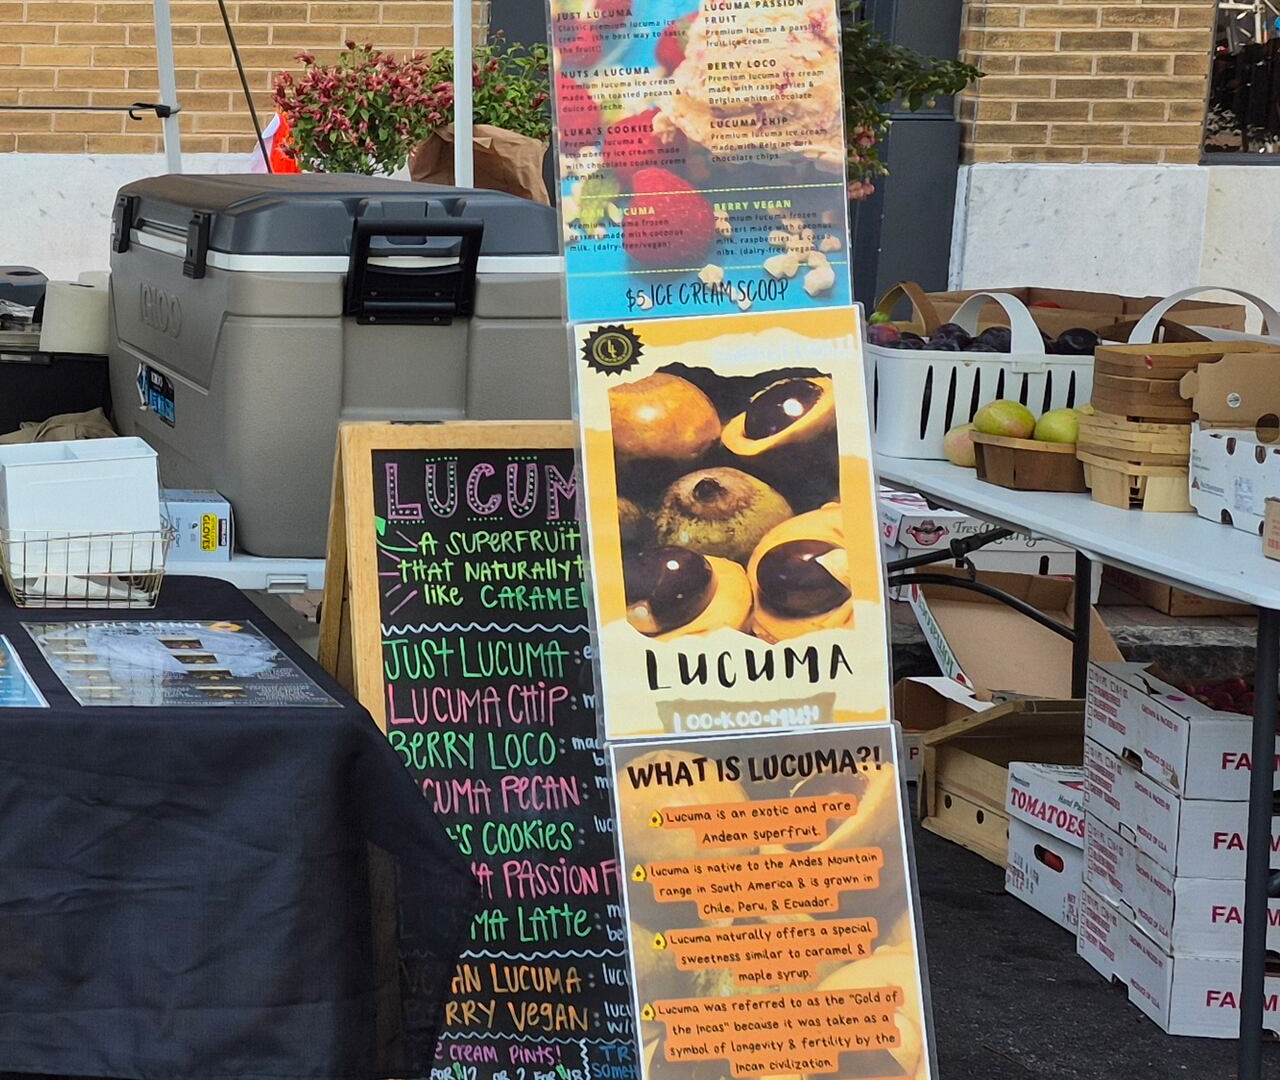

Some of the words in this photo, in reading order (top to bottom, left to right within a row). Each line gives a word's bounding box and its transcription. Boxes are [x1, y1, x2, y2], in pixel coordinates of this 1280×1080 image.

[704, 1, 751, 12] LUCUMA
[704, 15, 737, 24] FRUIT
[707, 61, 742, 71] BERRY
[747, 59, 777, 68] LOCO
[713, 201, 749, 211] BERRY
[754, 199, 791, 210] VEGAN
[626, 288, 645, 312] $5
[651, 283, 673, 305] ICE
[679, 280, 733, 306] CREAM
[738, 277, 789, 301] SCOOP
[460, 637, 570, 678] LUCUMA
[645, 644, 854, 691] LUCUMA
[388, 684, 503, 727] LUCUMA
[627, 758, 708, 789] WHAT
[719, 756, 740, 782] IS
[748, 746, 882, 782] LUCUMA?!
[666, 810, 712, 823] Lucuma
[716, 809, 725, 819] is
[731, 809, 746, 818] an
[751, 805, 789, 817] exotic
[794, 802, 816, 814] and
[822, 801, 851, 812] rare
[1011, 787, 1085, 838] TOMATOES
[702, 830, 748, 843] Andean
[753, 826, 821, 841] superfruit.
